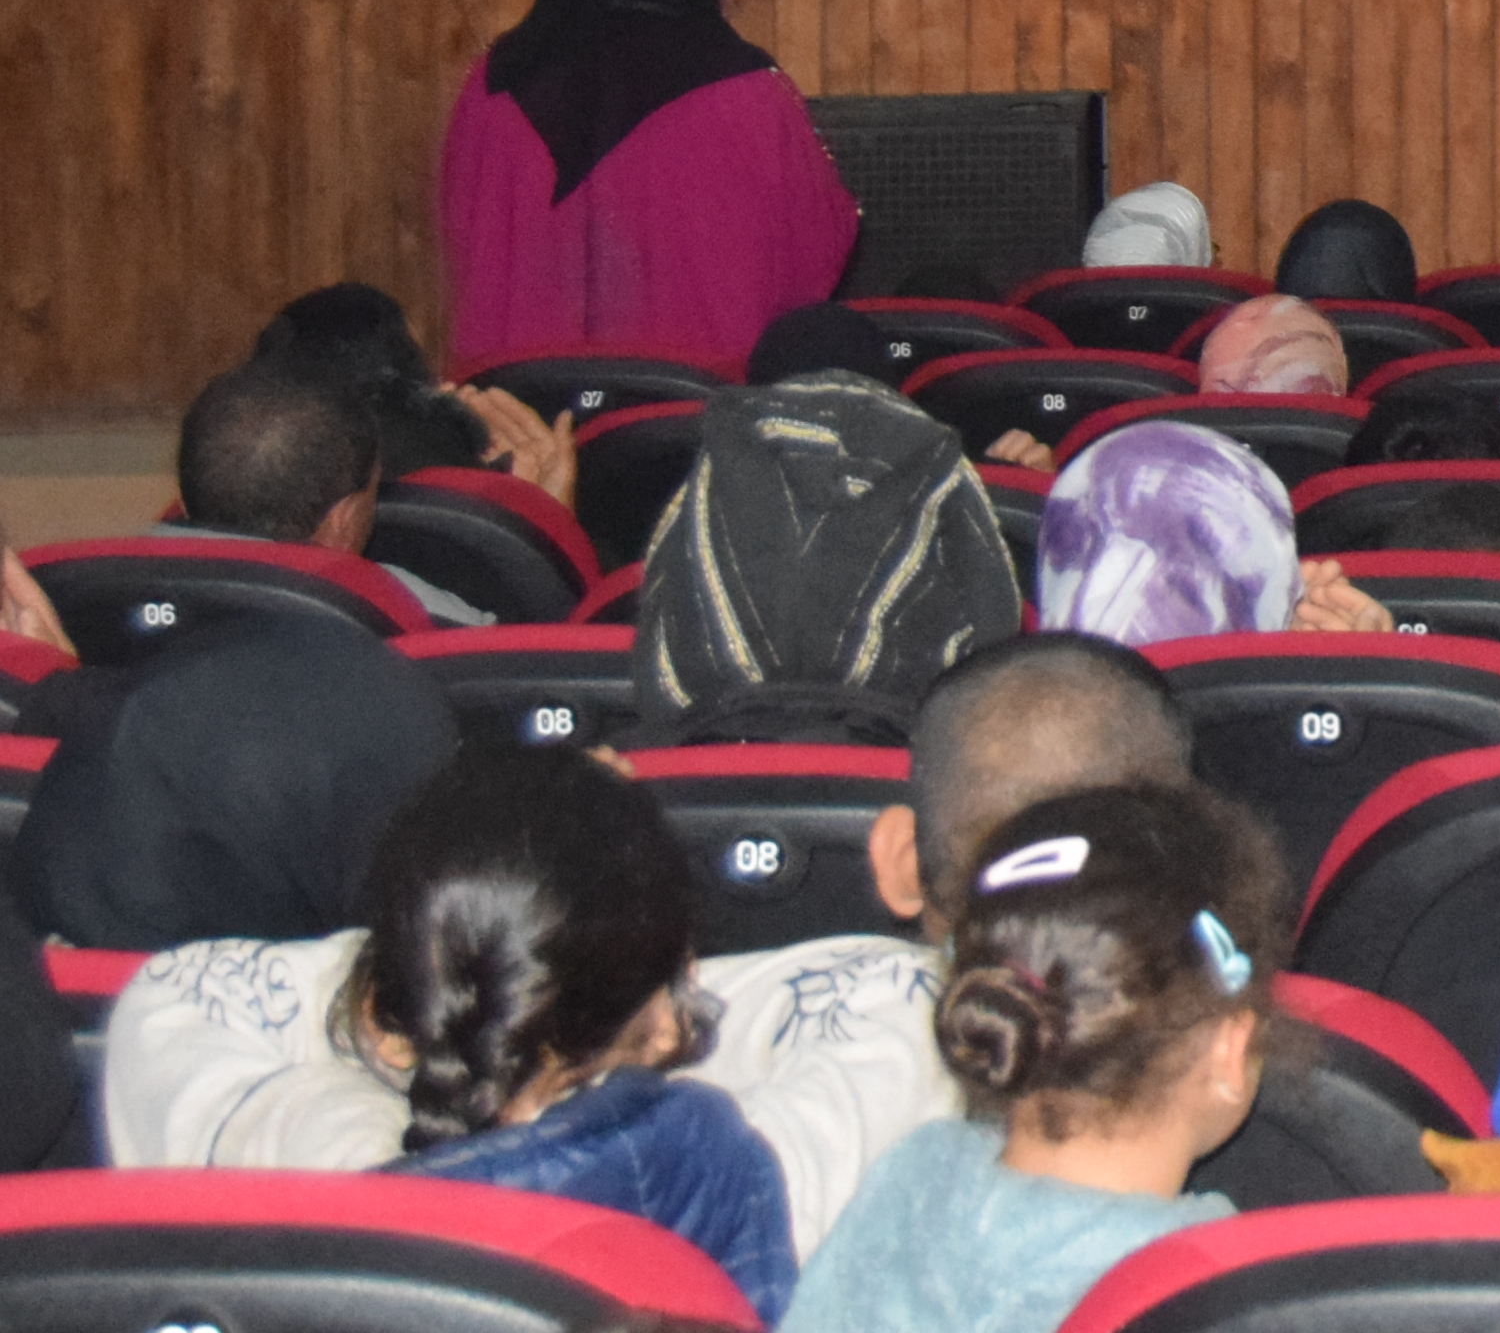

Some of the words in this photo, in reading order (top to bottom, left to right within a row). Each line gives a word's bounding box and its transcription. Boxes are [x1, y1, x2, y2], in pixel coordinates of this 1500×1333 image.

[1129, 306, 1148, 321] 07
[580, 389, 605, 409] 07
[1043, 393, 1066, 412] 08
[143, 602, 176, 627] 06
[534, 707, 574, 737] 08
[1301, 711, 1341, 743] 09
[736, 838, 781, 875] 08
